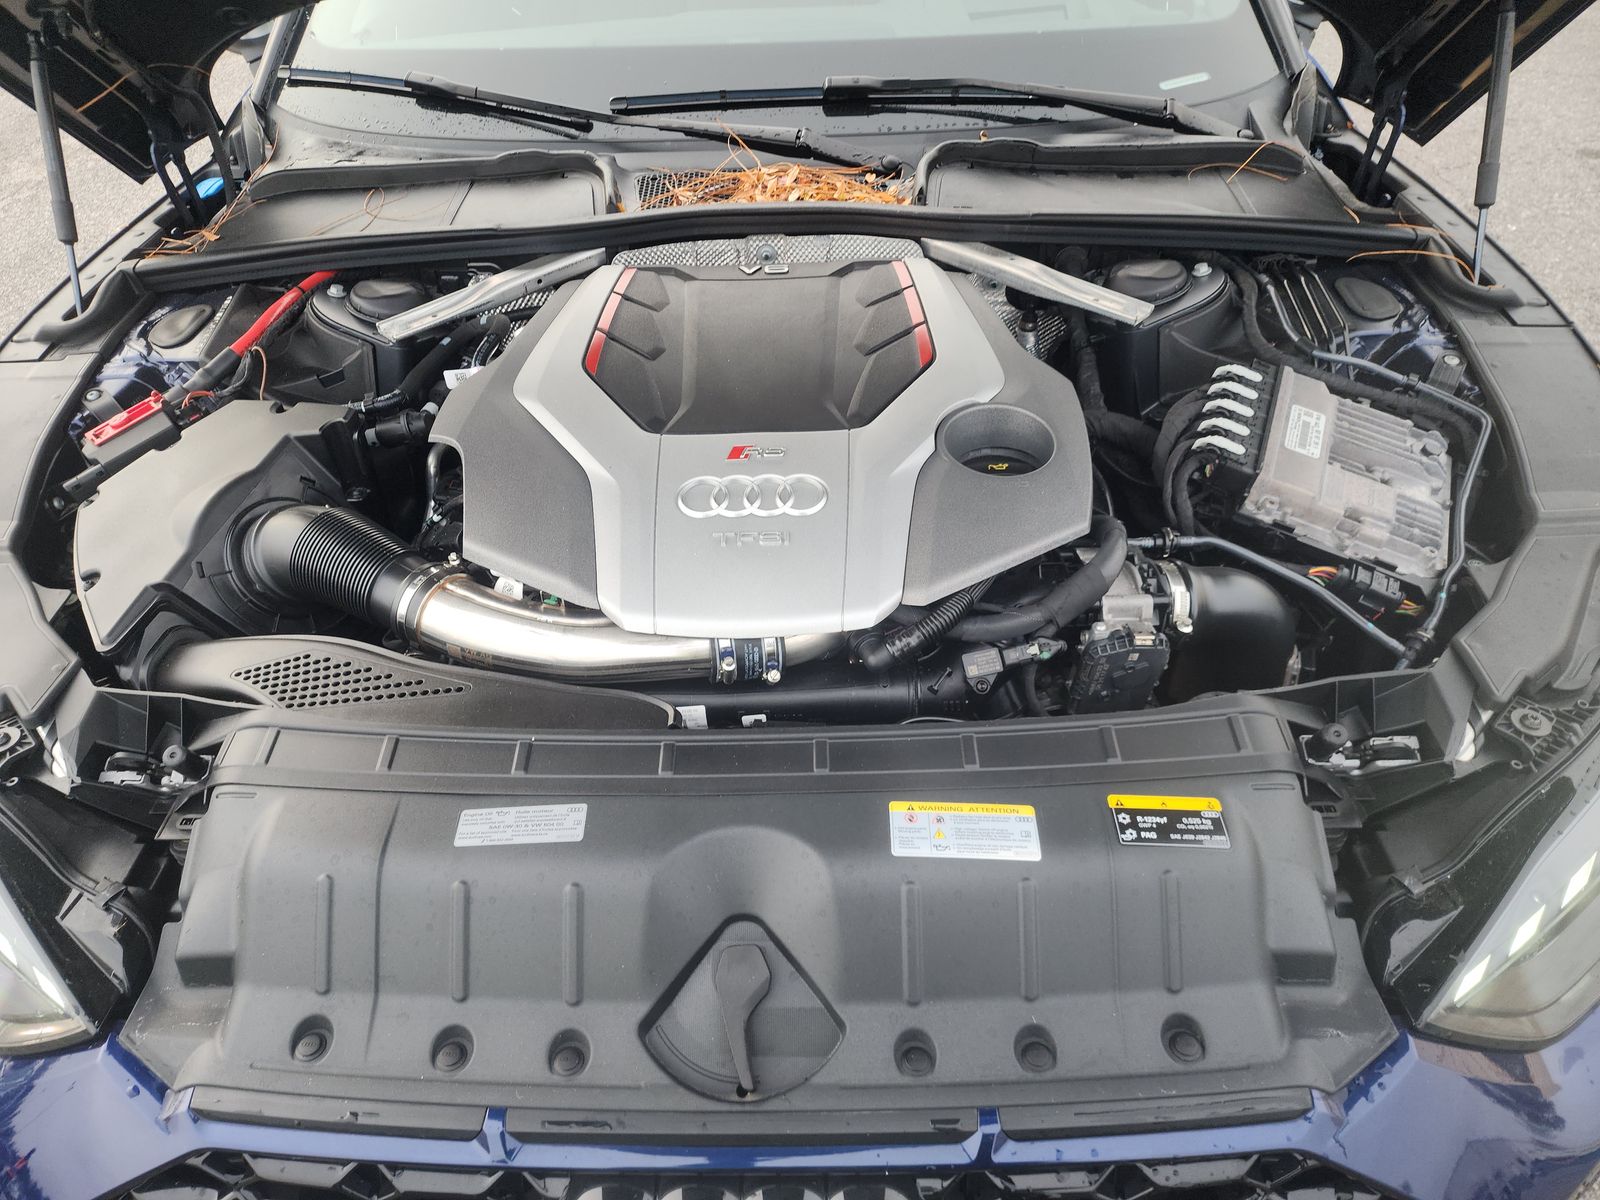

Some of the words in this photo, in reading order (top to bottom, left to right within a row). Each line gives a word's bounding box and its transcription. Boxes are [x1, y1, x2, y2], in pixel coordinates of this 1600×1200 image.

[735, 445, 786, 459] RS
[712, 530, 791, 547] TFSI
[918, 805, 964, 813] WARNING
[968, 806, 1020, 815] ATTENTION
